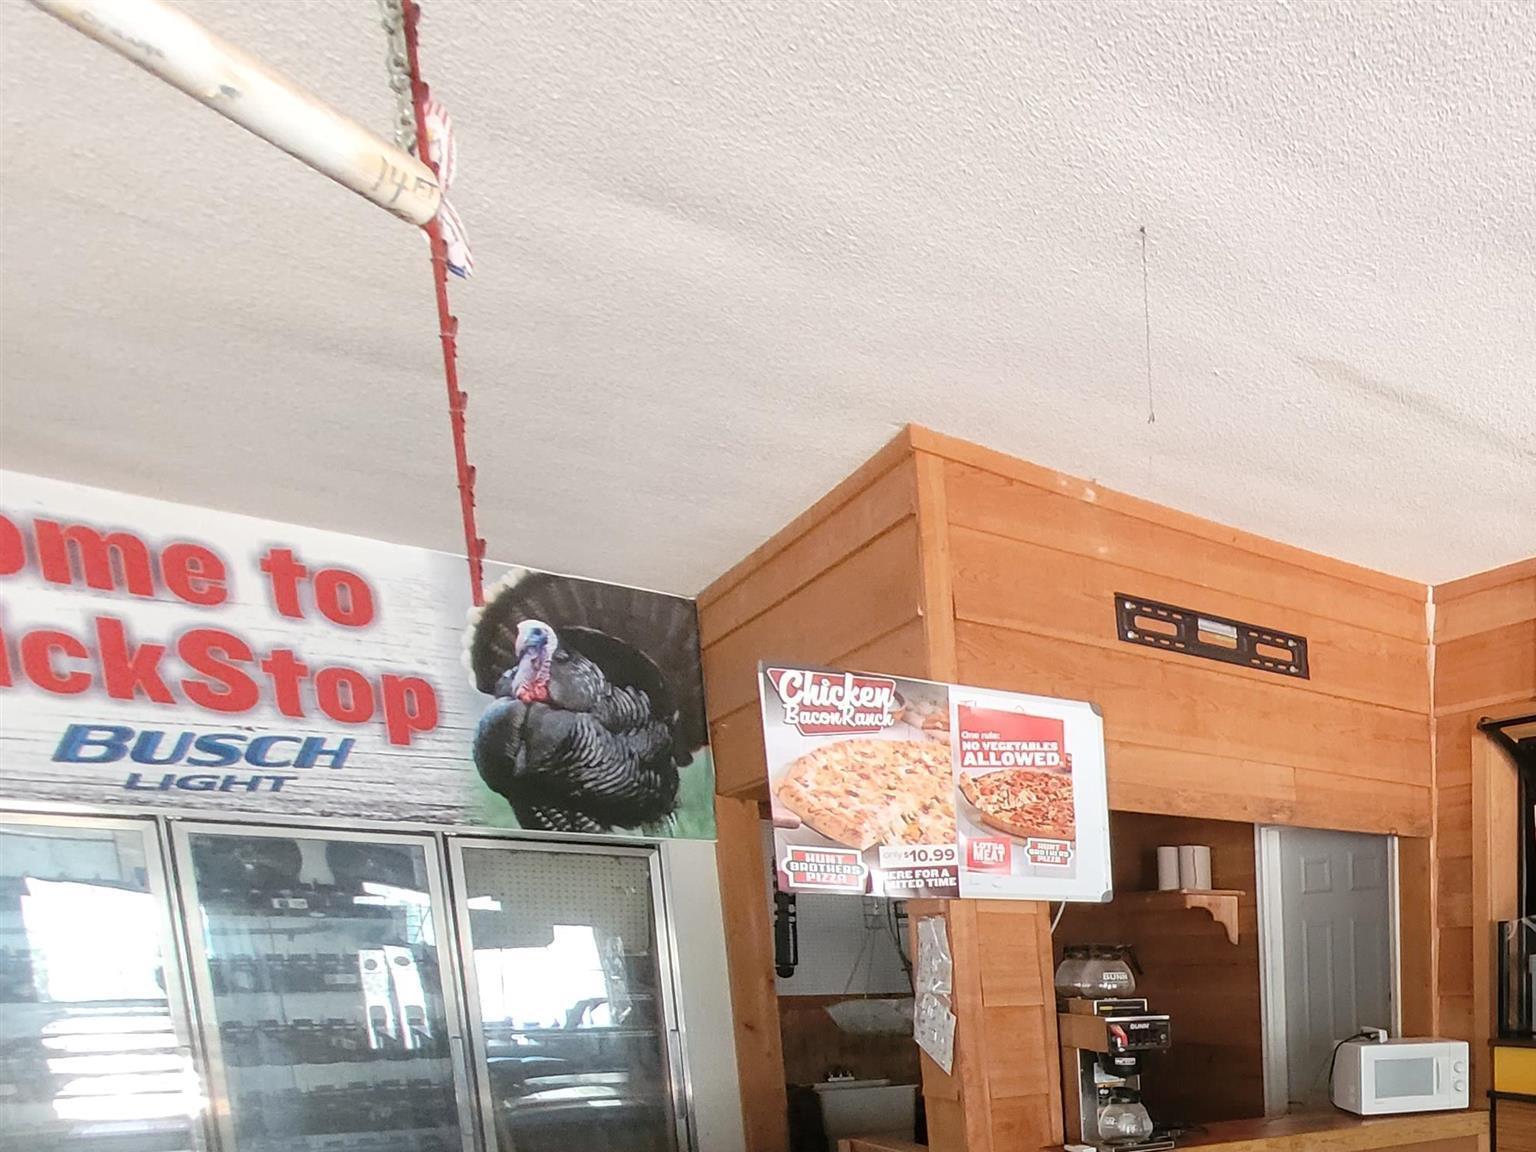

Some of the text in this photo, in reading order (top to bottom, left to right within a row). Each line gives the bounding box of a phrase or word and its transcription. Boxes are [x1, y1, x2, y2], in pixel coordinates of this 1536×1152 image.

[259, 547, 375, 628] to
[779, 670, 895, 709] Chicken
[783, 703, 895, 727] Bacon Ranch
[51, 723, 357, 769] BUSCH
[962, 741, 1058, 751] NO VEGETABLES
[122, 772, 299, 793] LIGHT
[805, 854, 845, 864] HUNT
[904, 849, 955, 863] $10.99
[973, 847, 1006, 863] MEAT
[789, 862, 862, 875] BROTHERS
[915, 869, 939, 879] FOR
[941, 868, 950, 877] A
[806, 873, 848, 884] PIZZA
[926, 877, 957, 887] TIME
